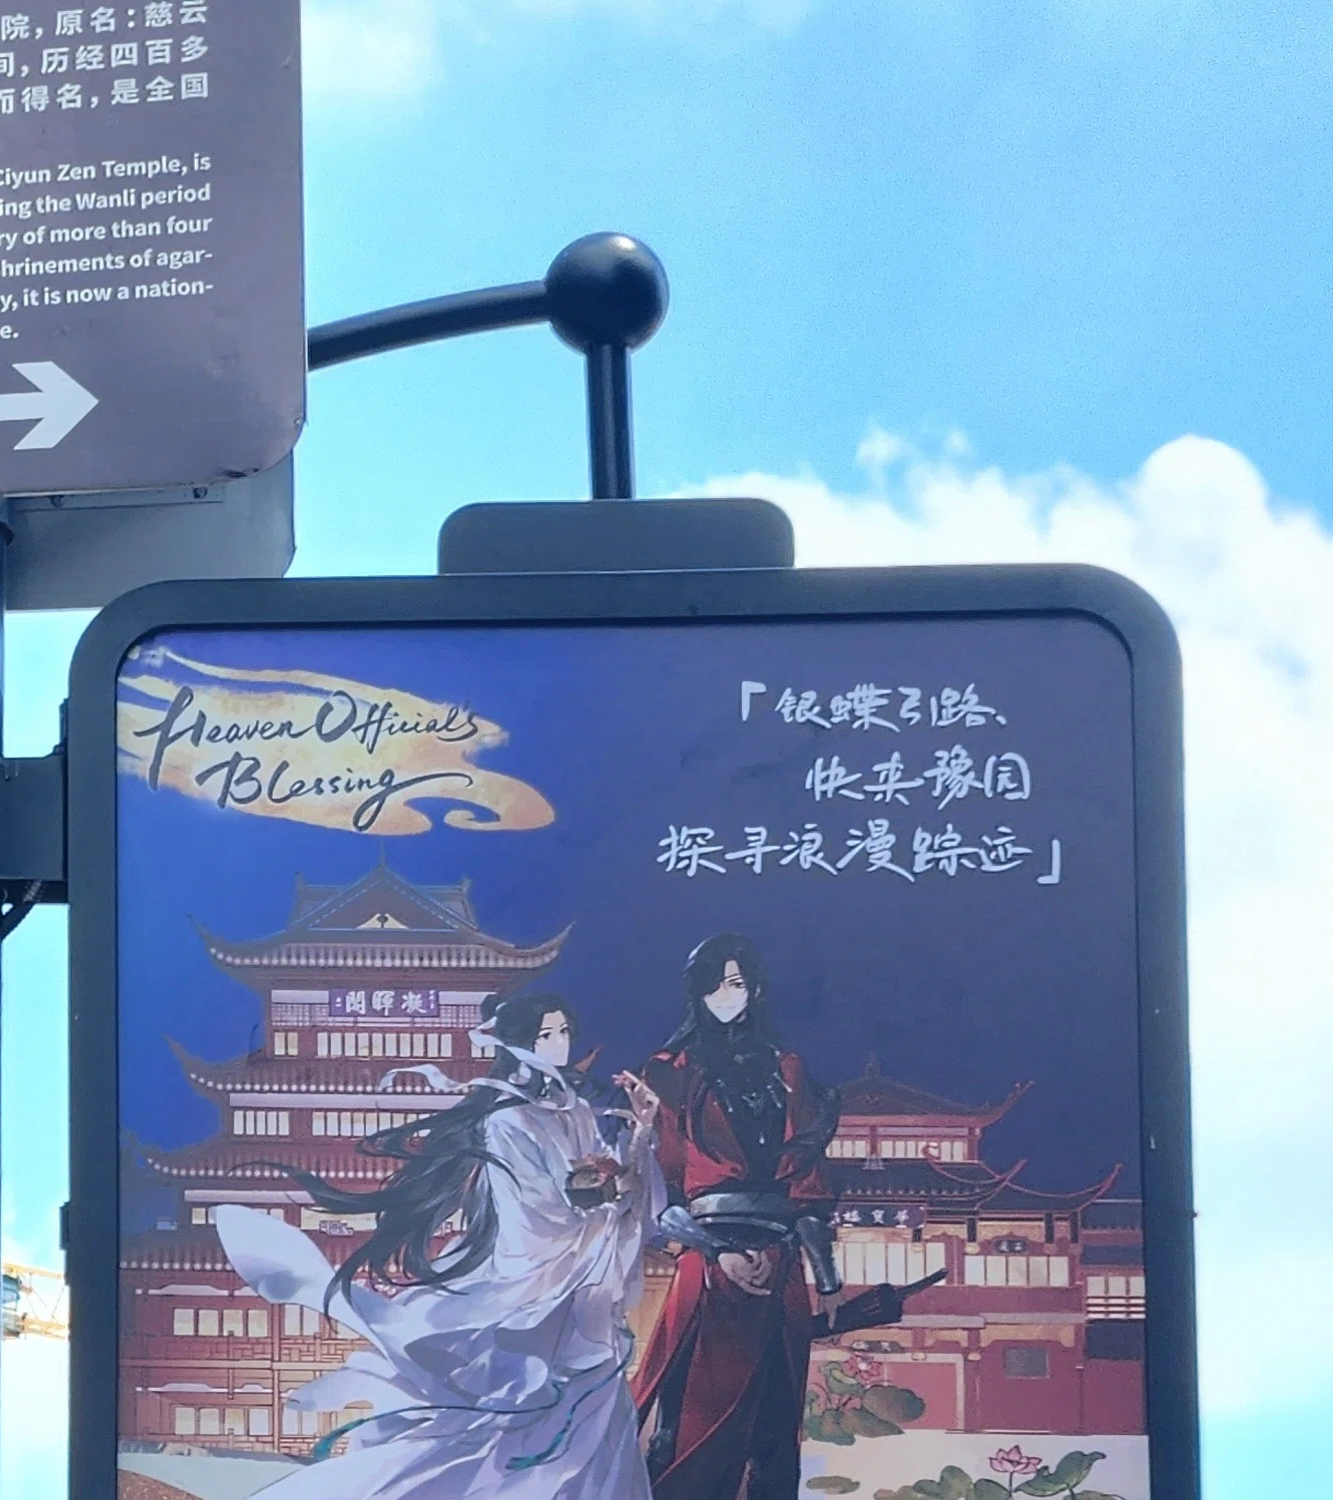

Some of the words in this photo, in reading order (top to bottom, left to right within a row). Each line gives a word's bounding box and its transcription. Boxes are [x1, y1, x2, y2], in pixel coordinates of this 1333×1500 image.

[56, 164, 96, 181] Zen
[100, 155, 188, 178] Temple,
[193, 153, 211, 171] is
[35, 195, 71, 213] the
[75, 188, 135, 210] Wanli
[140, 183, 210, 209] period
[22, 226, 46, 244] of
[49, 226, 106, 243] more
[110, 220, 161, 238] than
[166, 216, 213, 234] four
[129, 250, 153, 268] of
[156, 250, 212, 269] agar-
[22, 289, 39, 306] it
[43, 288, 61, 305] is
[66, 288, 112, 303] now
[116, 286, 129, 300] a
[134, 279, 213, 299] nation-
[134, 686, 305, 791] Heaven
[195, 751, 473, 832] Blessing
[805, 744, 1031, 810] 快来豫园
